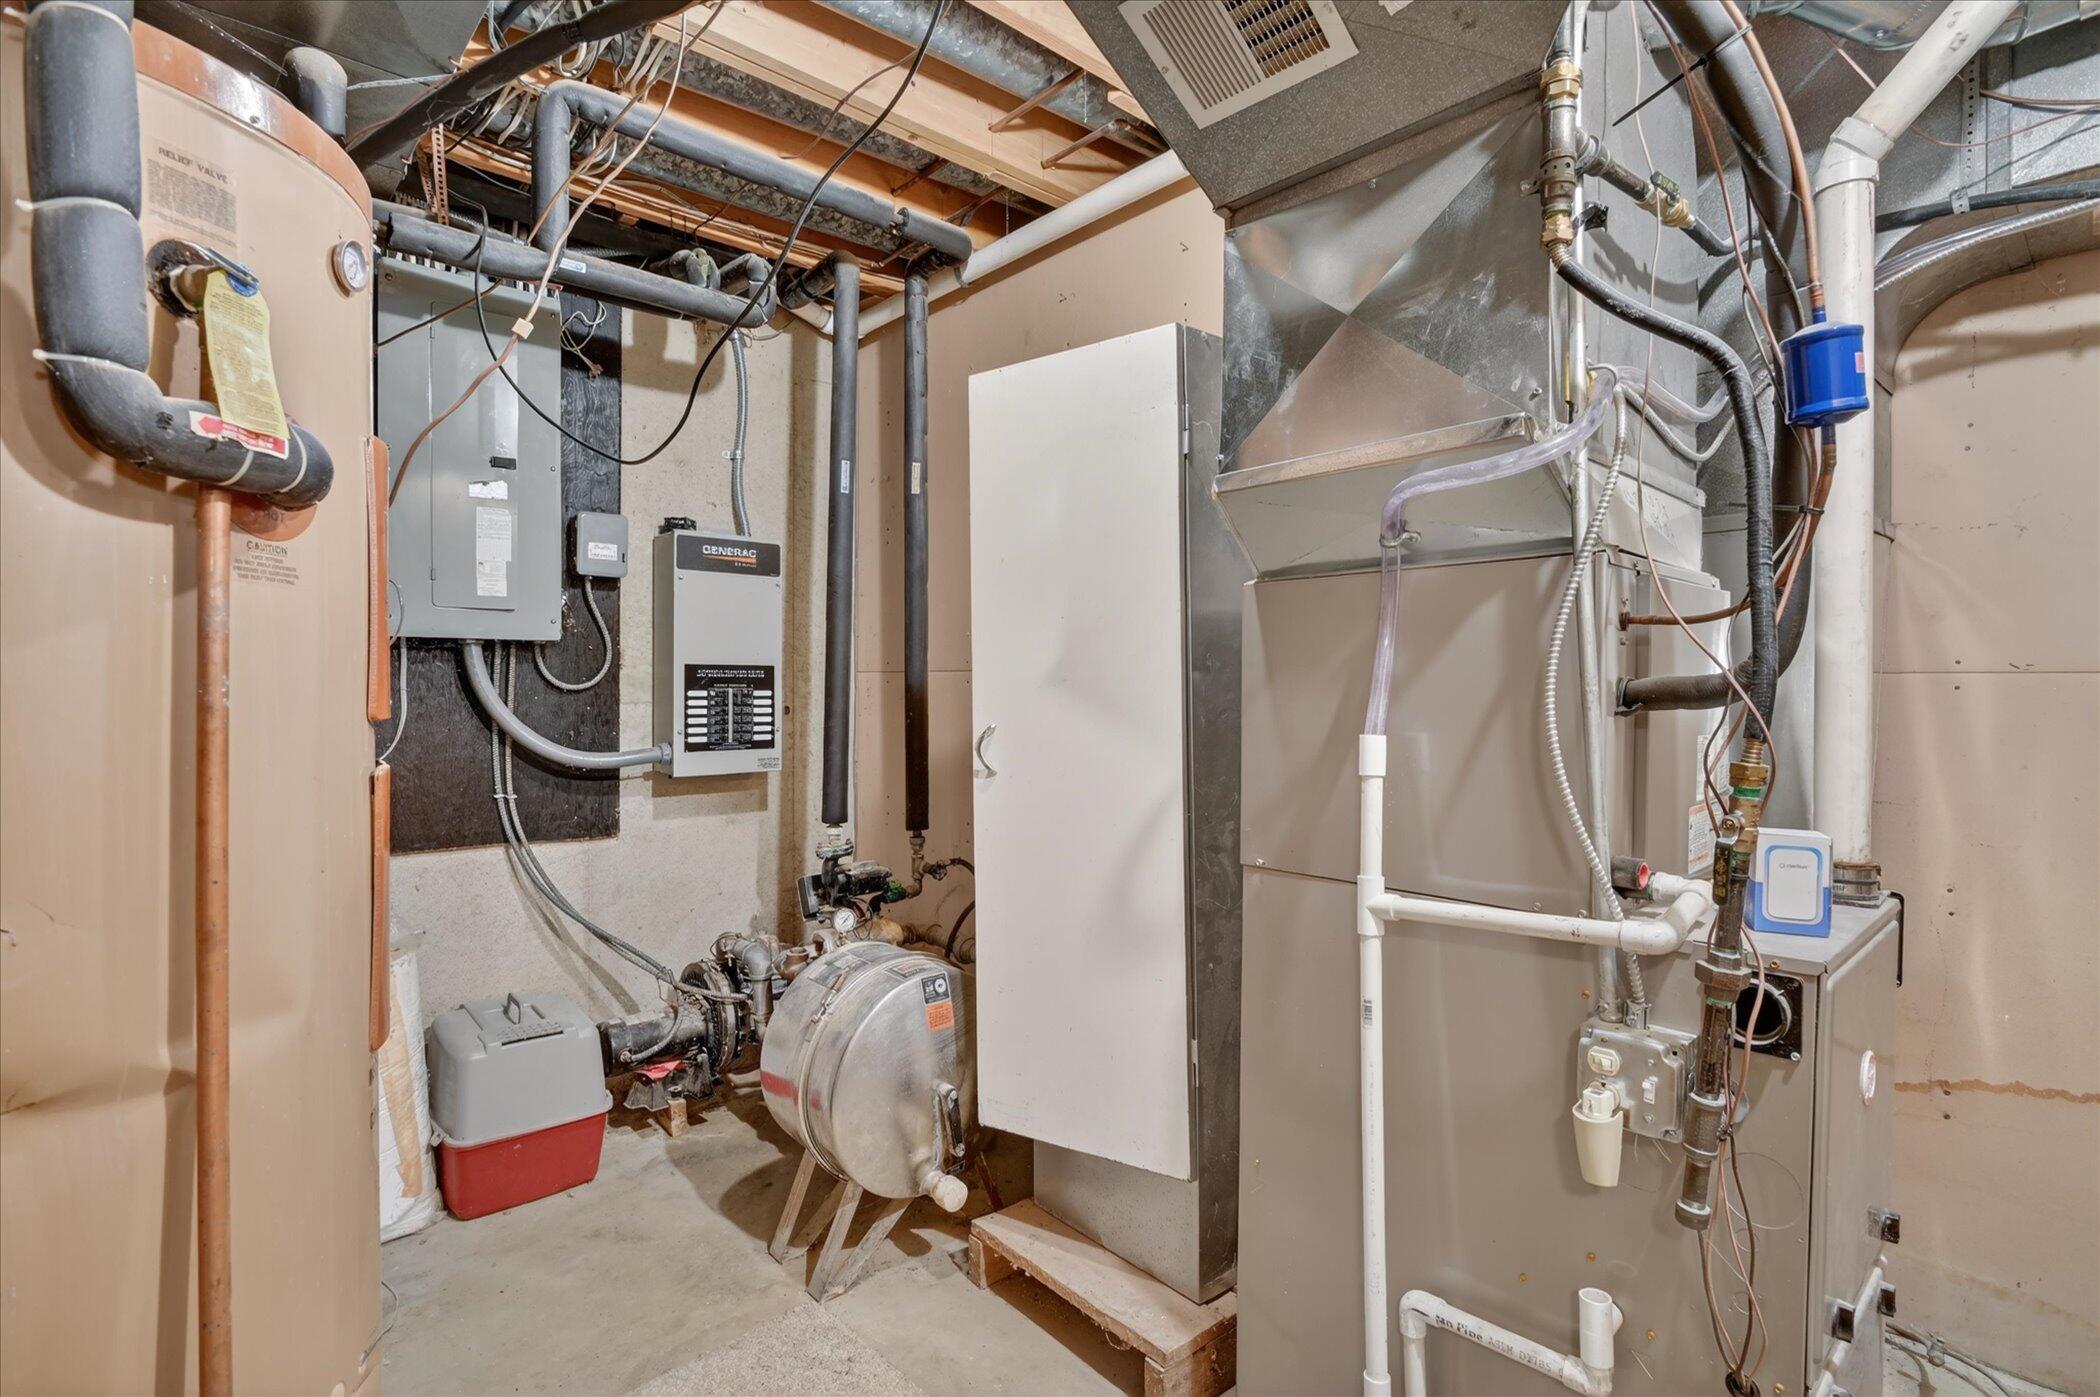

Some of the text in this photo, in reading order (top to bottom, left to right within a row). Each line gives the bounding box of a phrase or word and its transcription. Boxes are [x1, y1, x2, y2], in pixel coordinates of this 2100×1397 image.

[158, 147, 228, 184] RELIEF VALVE
[246, 540, 288, 555] CAUTION
[702, 544, 757, 558] GENERAC
